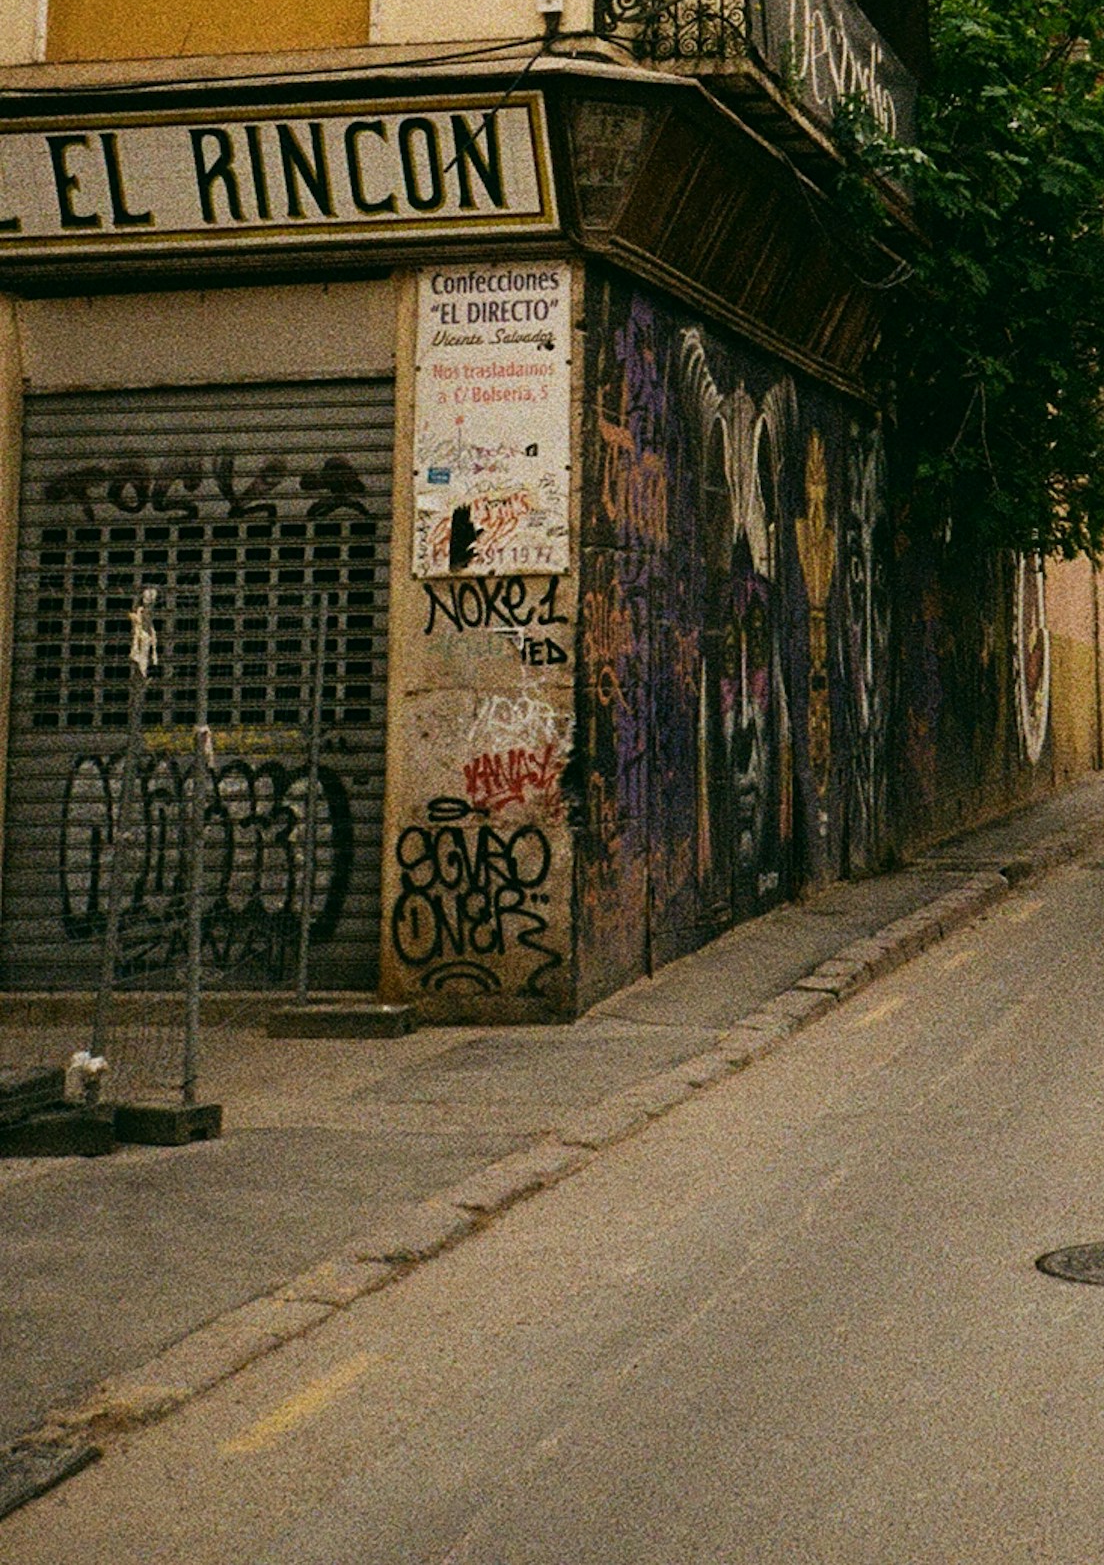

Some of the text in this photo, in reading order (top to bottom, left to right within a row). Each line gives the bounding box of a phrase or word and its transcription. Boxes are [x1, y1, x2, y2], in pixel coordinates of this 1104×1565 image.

[45, 111, 510, 231] EL RINCON
[431, 270, 560, 295] Confecciones
[432, 328, 557, 347] Vicente Salvador
[433, 361, 557, 380] Nos trasladamos
[437, 391, 448, 405] a
[541, 384, 550, 401] 5
